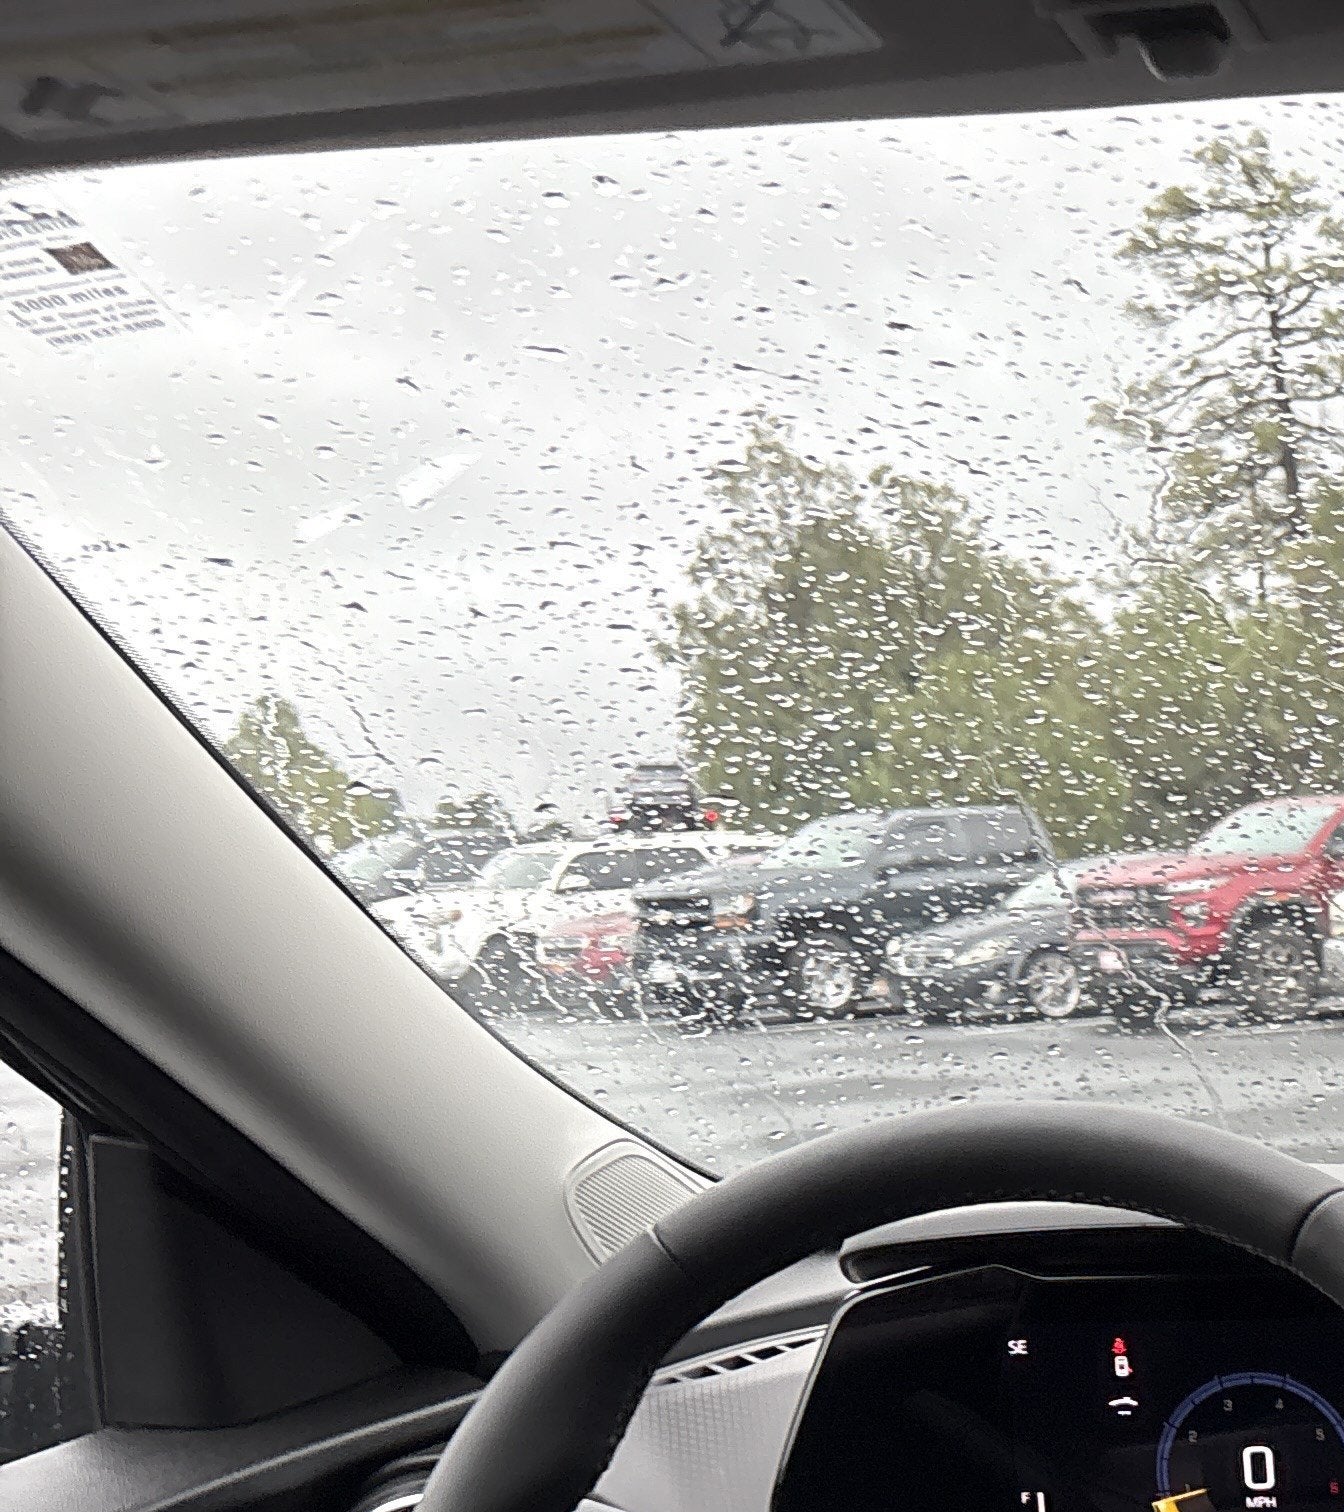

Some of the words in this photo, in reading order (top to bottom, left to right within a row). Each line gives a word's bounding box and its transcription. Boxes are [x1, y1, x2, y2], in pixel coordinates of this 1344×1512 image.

[68, 286, 129, 302] miles
[1008, 1339, 1028, 1355] SE
[1242, 1445, 1275, 1490] 0
[1021, 1492, 1031, 1504] F
[1246, 1497, 1277, 1508] MPH
